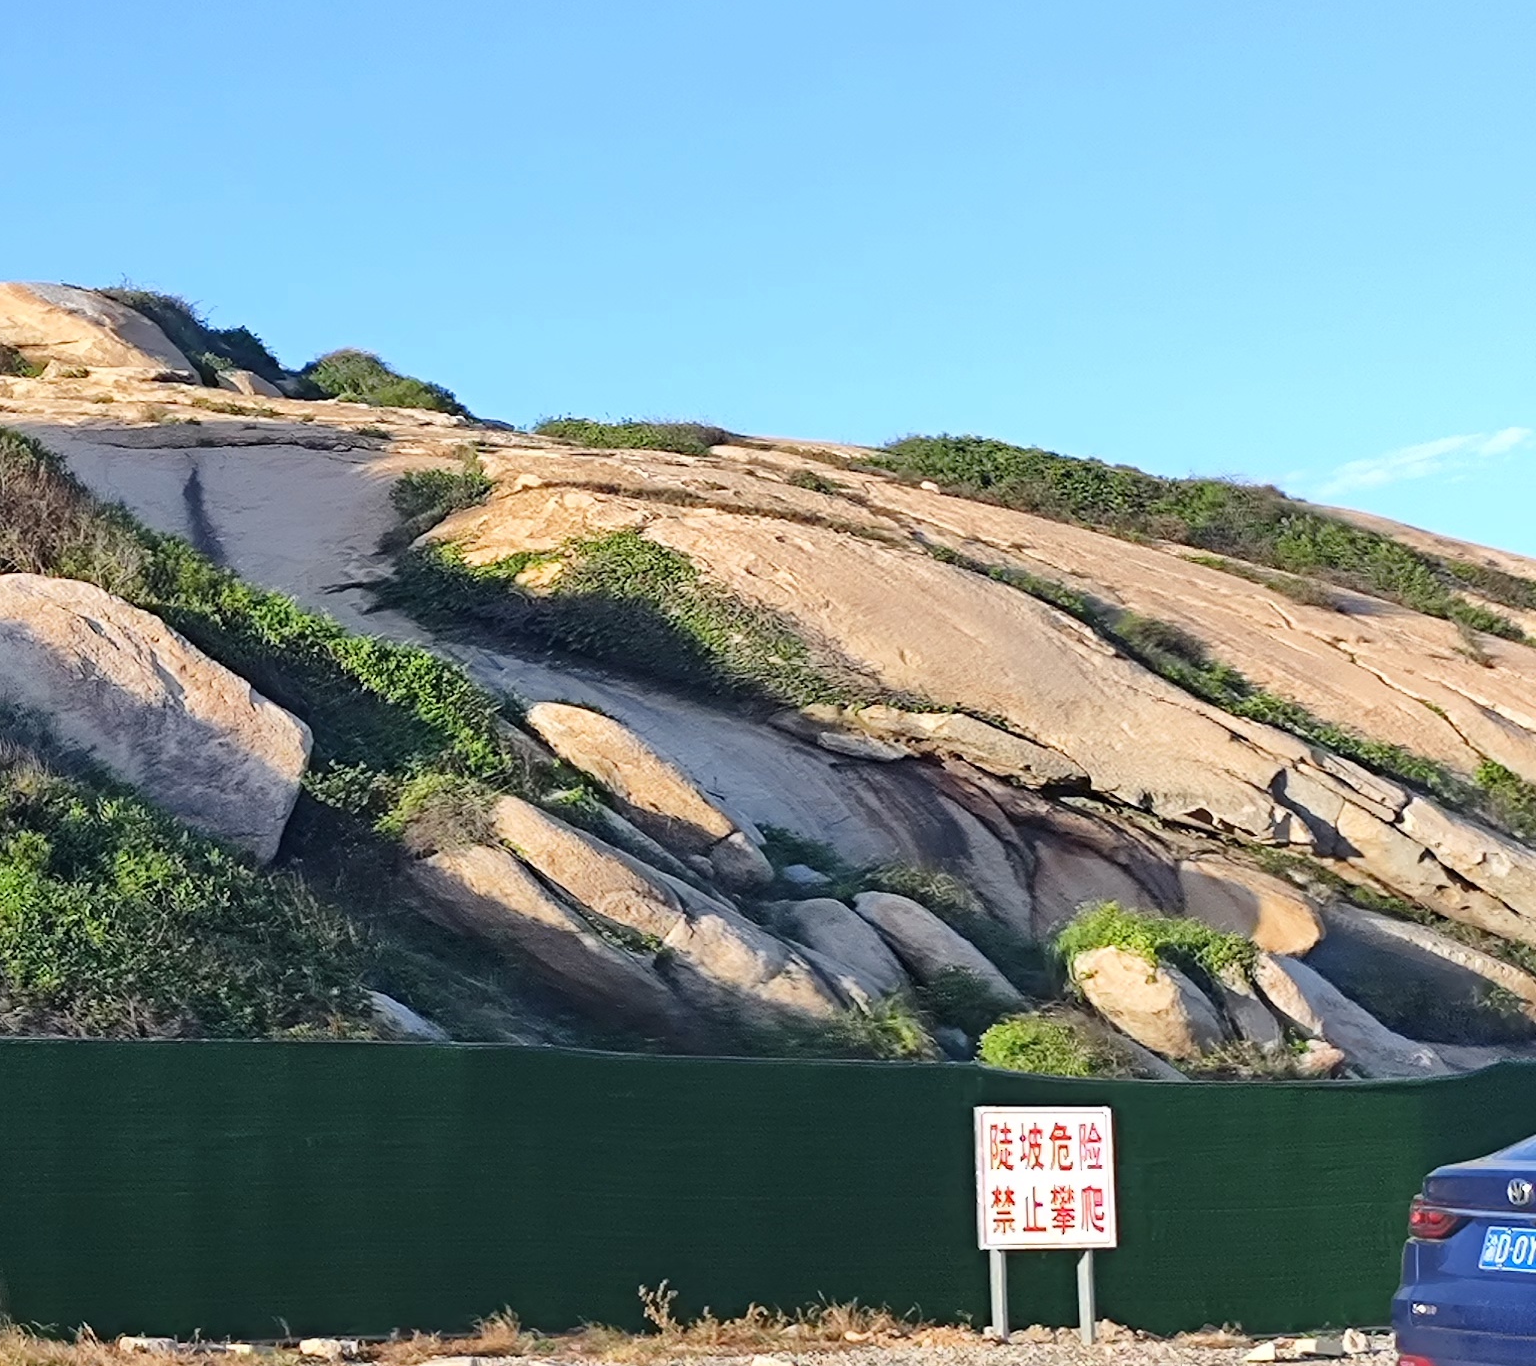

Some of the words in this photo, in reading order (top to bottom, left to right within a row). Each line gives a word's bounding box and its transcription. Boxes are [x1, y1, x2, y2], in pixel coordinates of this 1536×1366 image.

[990, 1122, 1103, 1171] 陡坡危险
[991, 1184, 1105, 1235] 禁止攀爬
